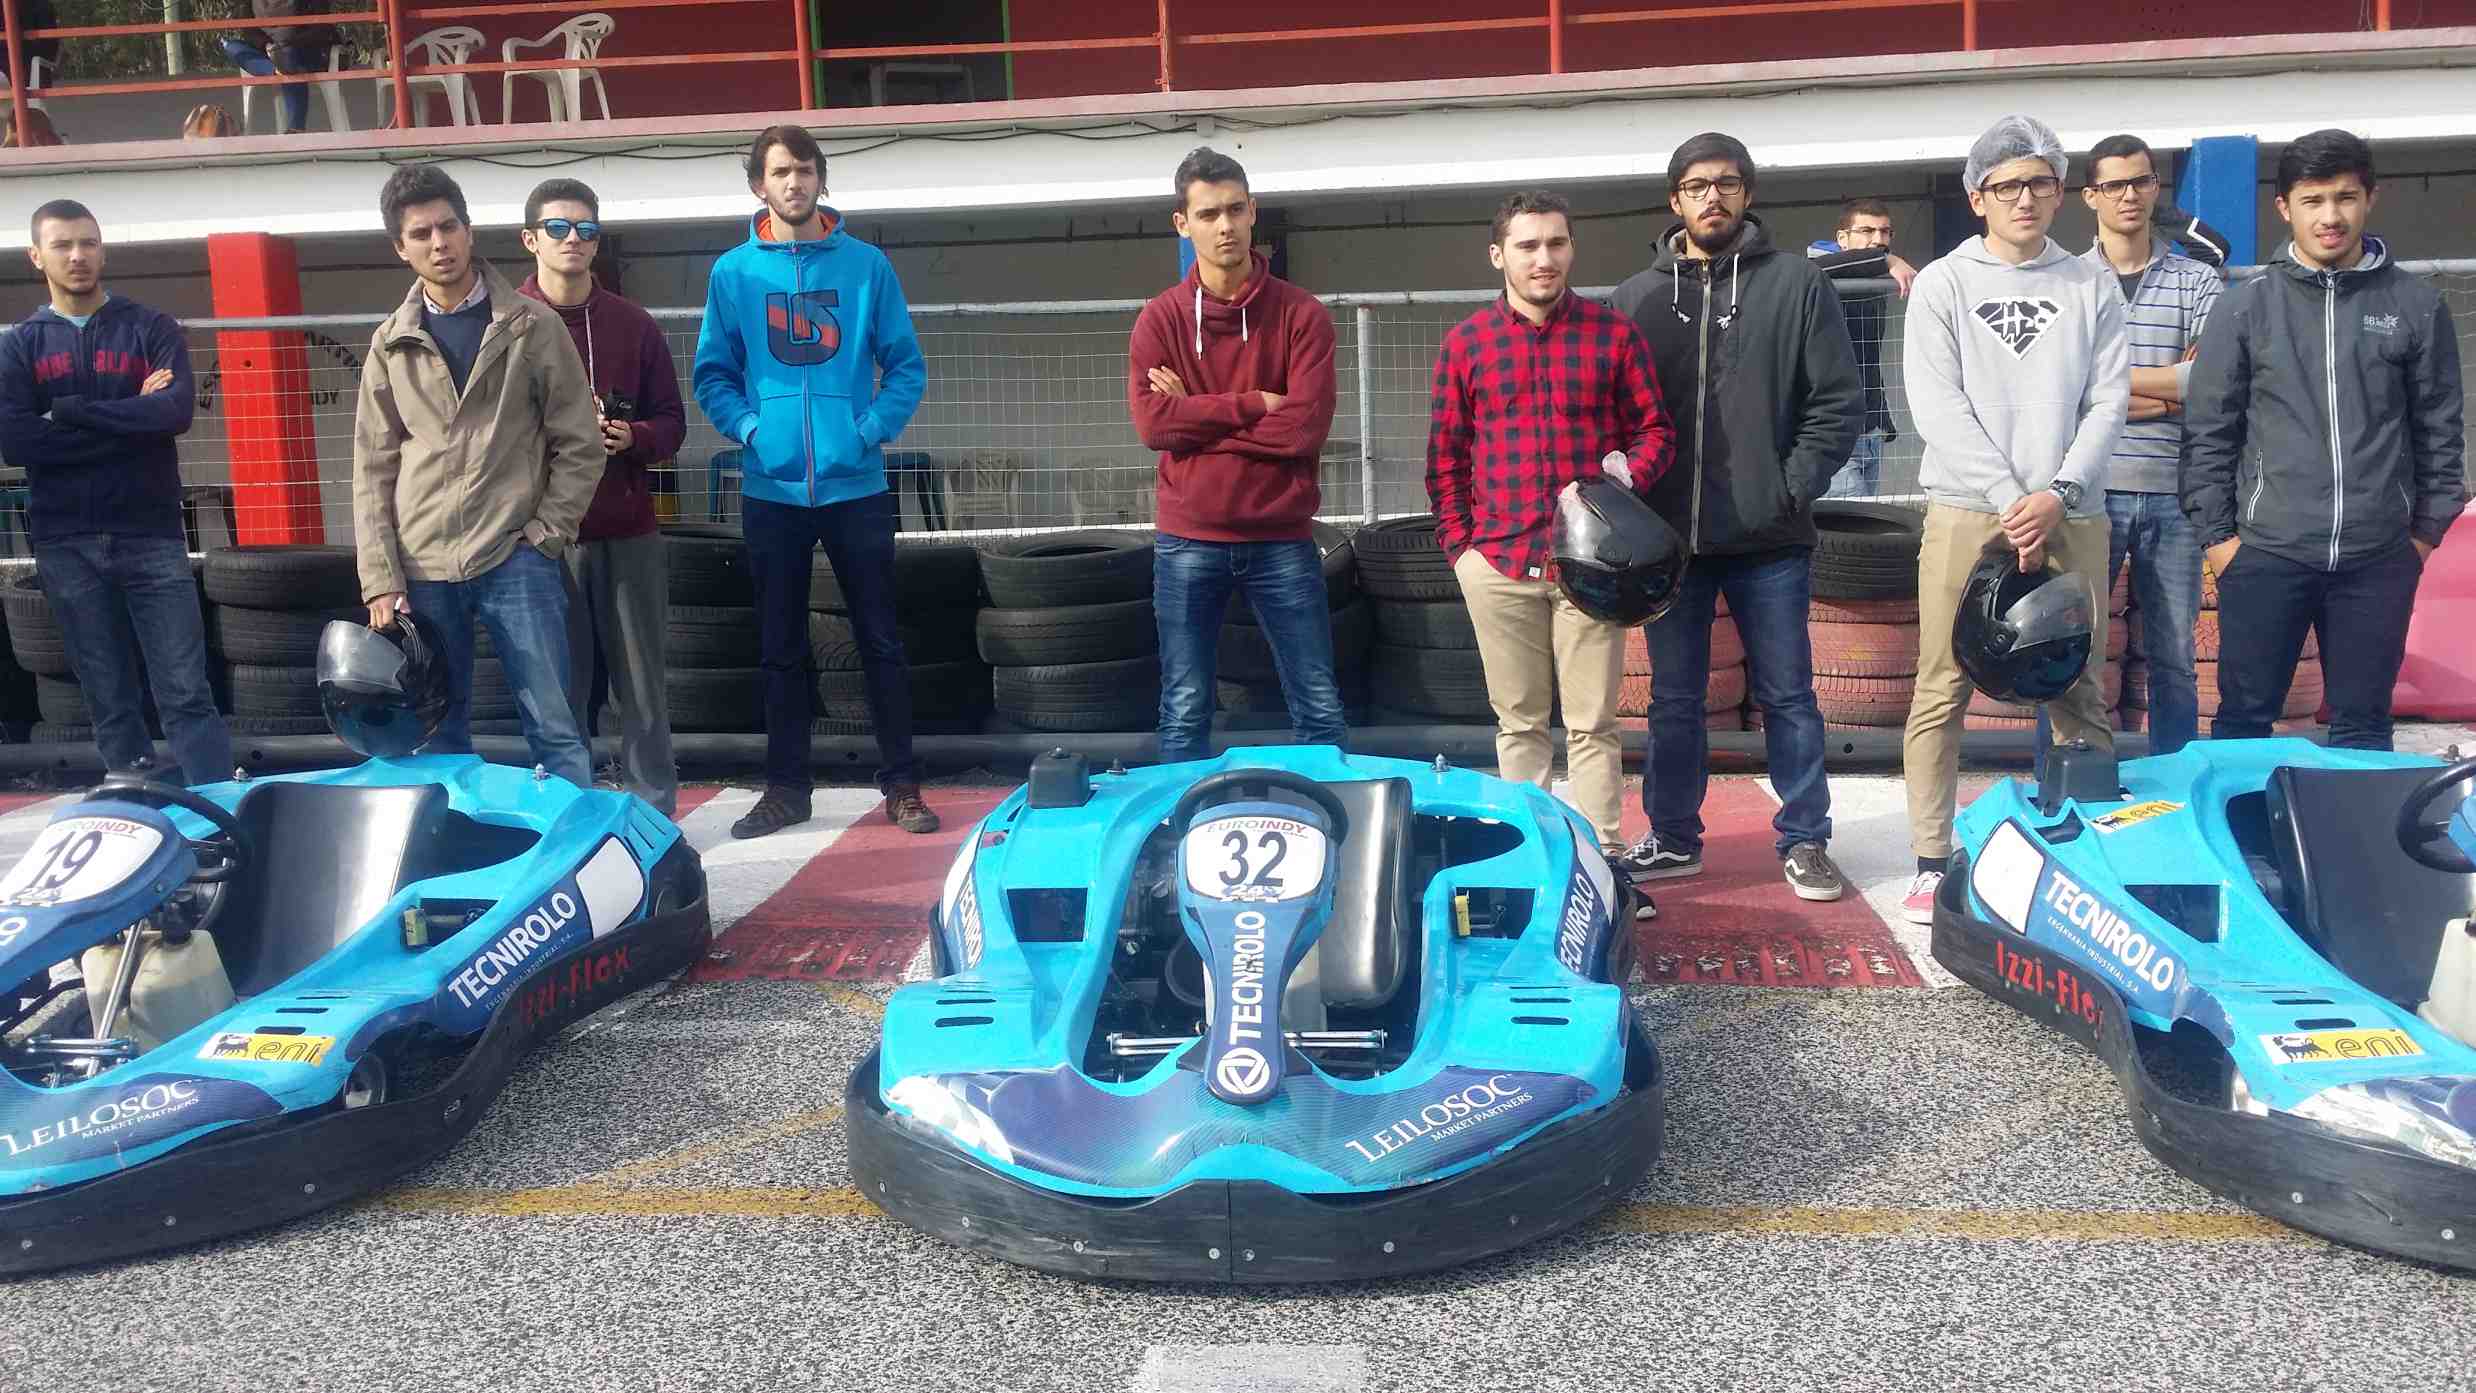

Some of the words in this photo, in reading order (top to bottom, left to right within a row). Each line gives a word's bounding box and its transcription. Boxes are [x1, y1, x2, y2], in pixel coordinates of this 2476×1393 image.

[1208, 819, 1308, 834] EUROINDY
[27, 830, 102, 889] 19
[1219, 830, 1288, 887] 32
[448, 892, 576, 1008] TECNIROLO
[2046, 870, 2175, 992] TECNIROLO
[1229, 911, 1266, 1045] TECNIROLO
[254, 1036, 328, 1063] eni
[2335, 1028, 2416, 1059] eni
[0, 1079, 197, 1155] LEILOSOC
[82, 1118, 134, 1139] MARKET
[136, 1096, 200, 1123] PARTNERS
[1344, 1074, 1521, 1162] LEILOSOC
[1431, 1118, 1475, 1142] MARKET
[1476, 1091, 1533, 1122] PARTNERS
